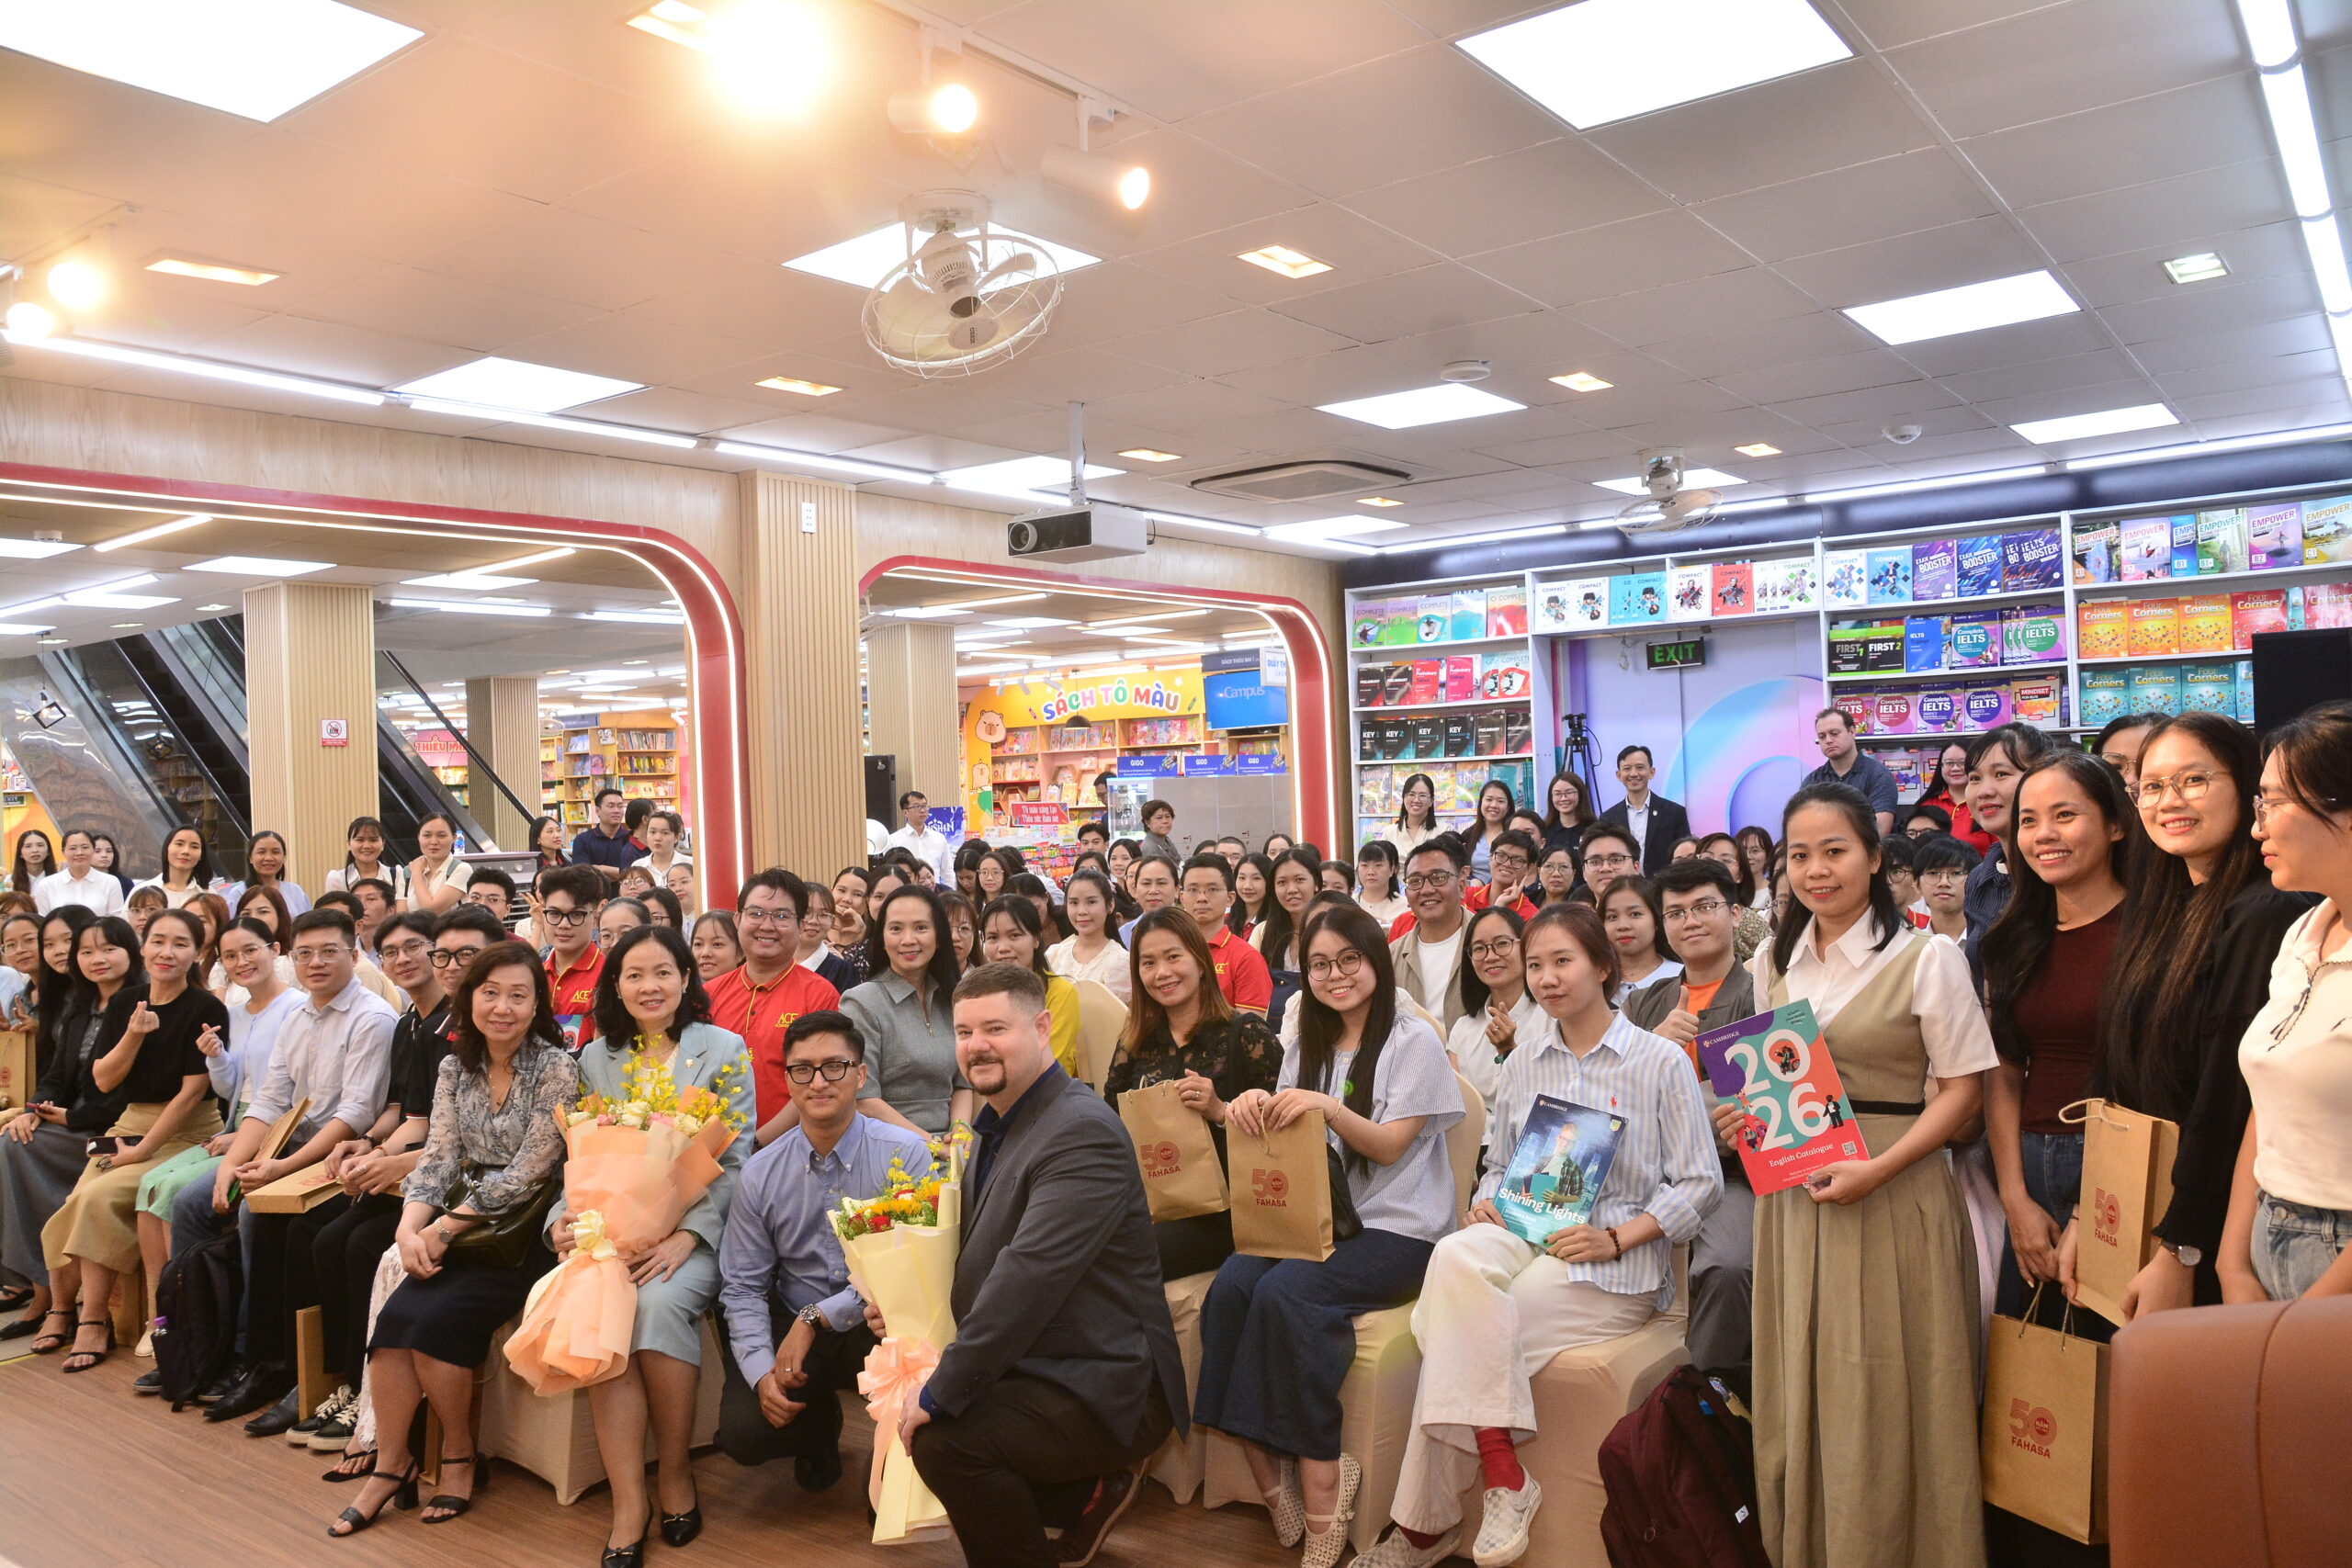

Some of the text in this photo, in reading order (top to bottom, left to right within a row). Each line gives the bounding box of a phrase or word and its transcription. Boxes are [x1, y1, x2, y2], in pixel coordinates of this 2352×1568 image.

[2306, 502, 2350, 522] EMPOWER
[2199, 516, 2241, 532] EMPOWER
[2252, 510, 2294, 528] EMPOWER
[2076, 528, 2115, 545] EMPOWER
[2124, 524, 2165, 540] EMPOWER
[2175, 525, 2196, 536] EMPO
[1959, 553, 1973, 561] EXAM
[2023, 543, 2059, 562] BOOSTER
[1916, 557, 1929, 565] EXAM
[1918, 556, 1952, 573] BOOSTER
[1962, 551, 1998, 570] BOOSTER
[2247, 593, 2267, 602] Four
[1420, 601, 1449, 609] COMPLETE
[2184, 604, 2226, 615] Corners
[2237, 599, 2279, 610] Corners
[1356, 607, 1384, 615] COMPLETE
[2084, 611, 2122, 621] Corners
[2133, 607, 2174, 617] Corners
[2026, 627, 2055, 638] IELTS
[1957, 634, 1985, 644] IELTS
[1836, 644, 1861, 653] FIRST
[1869, 642, 1902, 651] FIRST 2
[1654, 643, 1696, 663] EXIT
[2135, 675, 2176, 685] Corners
[2188, 672, 2229, 682] Corners
[2086, 680, 2125, 688] Corners
[1224, 685, 1266, 700] Campus
[2021, 687, 2050, 695] MINDSET
[1043, 679, 1180, 720] SÁCH TÔ MÀU
[1970, 698, 1998, 709] IELTS
[1880, 704, 1907, 714] IELTS
[1923, 701, 1951, 712] IELTS
[447, 741, 467, 753] NH
[1215, 963, 1228, 972] CE
[572, 987, 593, 999] ACE
[1709, 1030, 1740, 1045] CAMBRIDGE
[1724, 1029, 1811, 1096] 20
[1544, 1102, 1568, 1111] CAMBRIDGE
[1748, 1082, 1831, 1153] 26
[1140, 1140, 1181, 1171] 50
[1769, 1142, 1834, 1168] English Catalogue
[1148, 1165, 1182, 1179] FAHASA
[1251, 1168, 1289, 1200] 50
[1256, 1198, 1287, 1208] FAHASA
[1498, 1188, 1544, 1213] Shining
[1545, 1201, 1586, 1224] Lights
[2094, 1188, 2121, 1235] 50
[2095, 1228, 2118, 1247] FAHASA
[2008, 1397, 2058, 1447] 50
[2011, 1436, 2051, 1460] FAHASA
